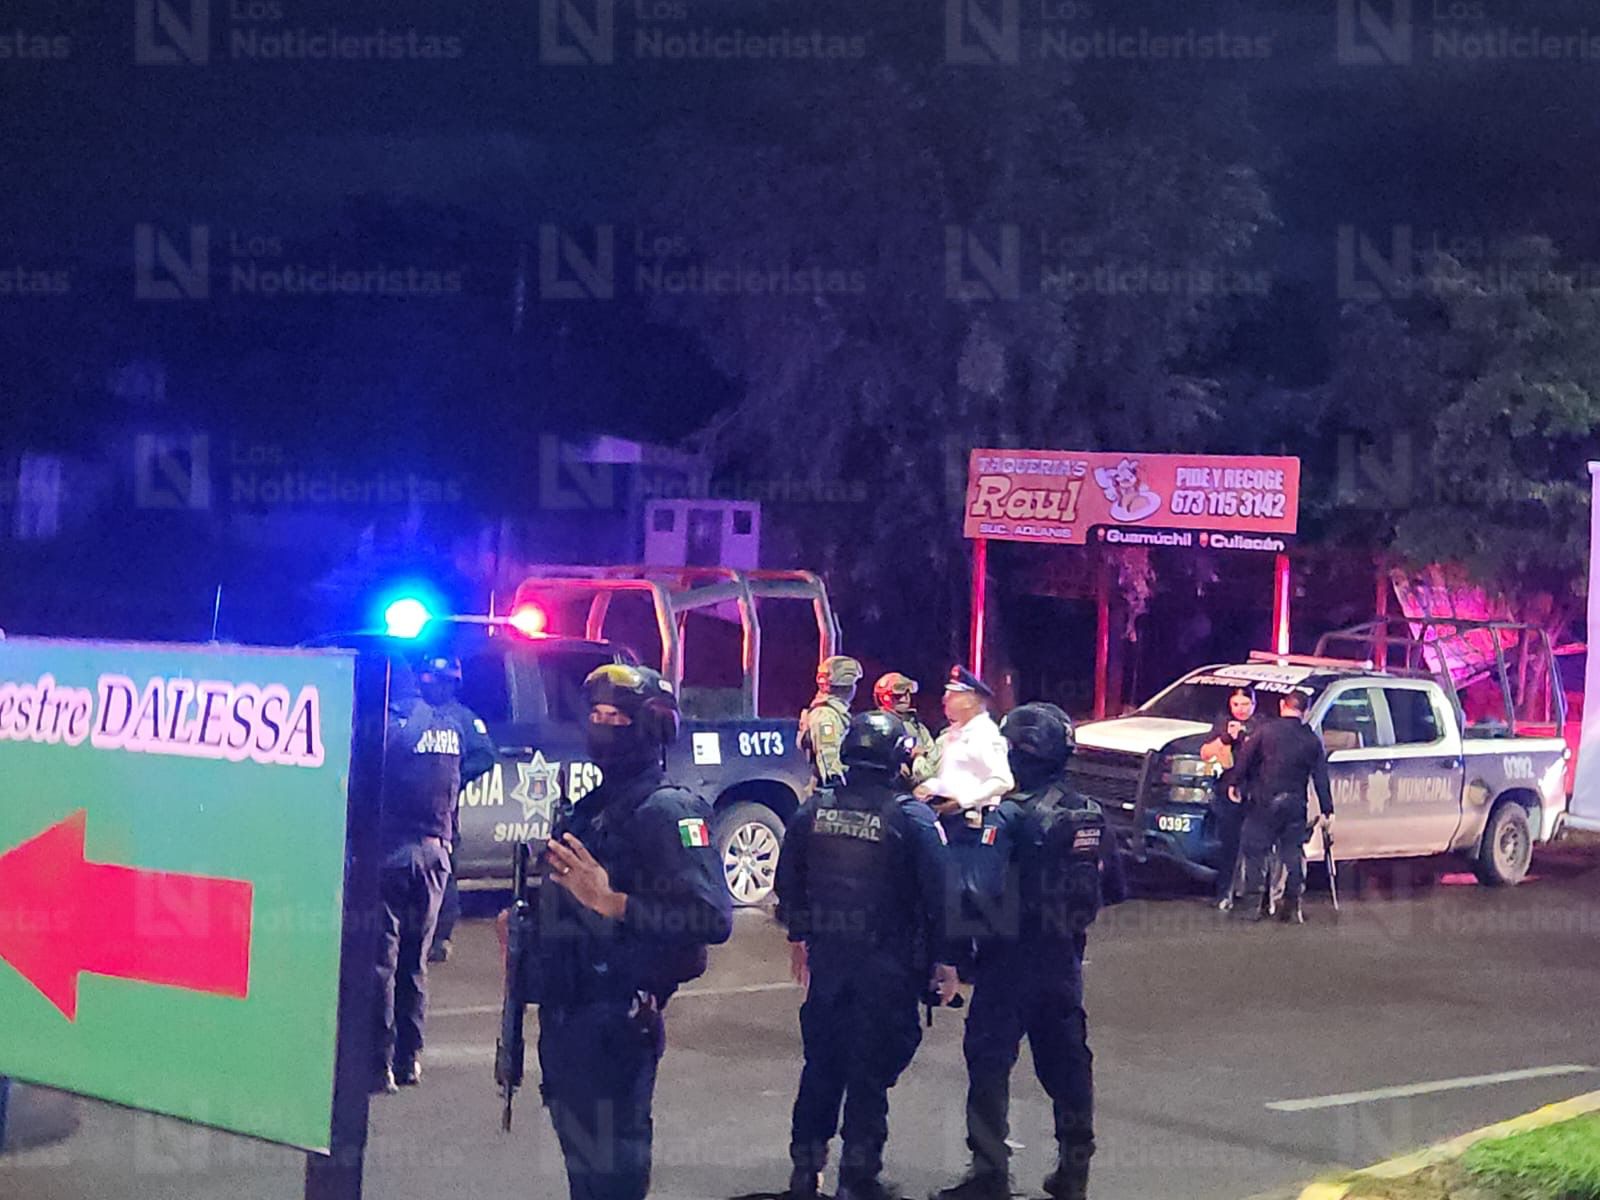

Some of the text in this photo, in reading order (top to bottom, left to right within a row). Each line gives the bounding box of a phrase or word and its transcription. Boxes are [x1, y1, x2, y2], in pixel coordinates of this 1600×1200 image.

[1175, 467, 1285, 490] PIDE Y RECOGE
[1171, 489, 1286, 517] 673 115 3142
[95, 679, 321, 761] DALESSA
[738, 731, 784, 756] 8173
[1158, 816, 1191, 832] 0392
